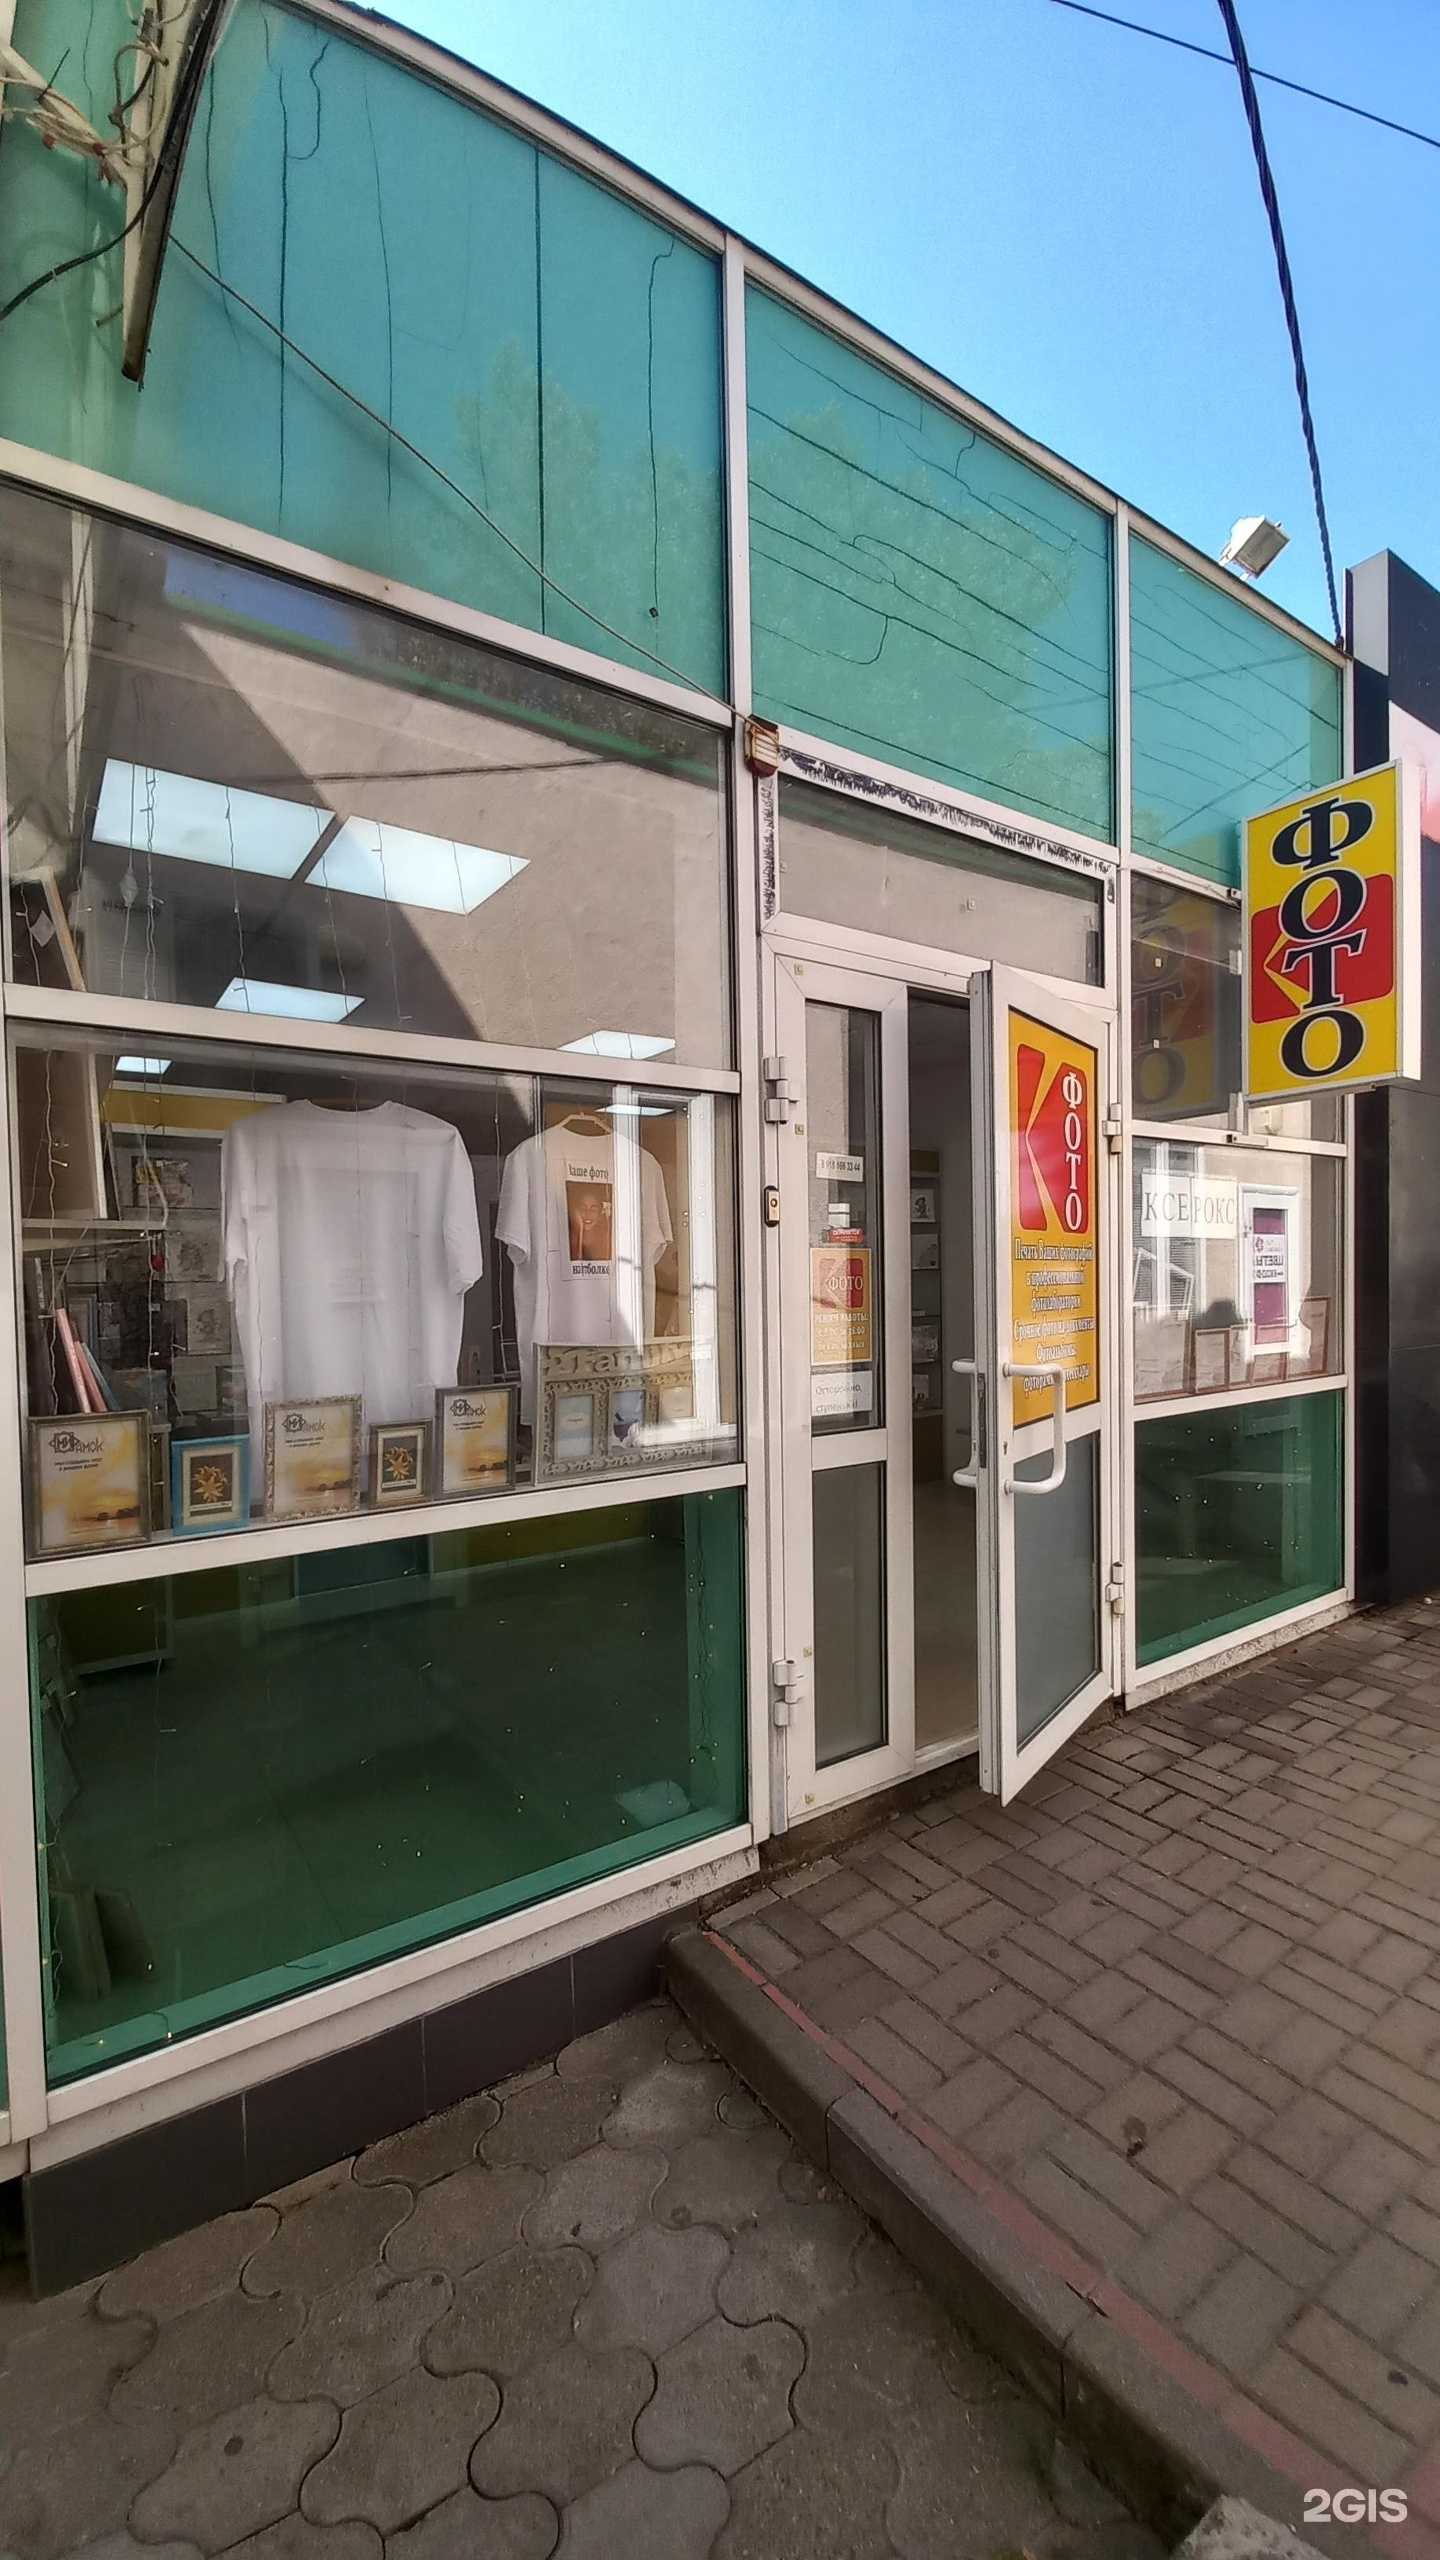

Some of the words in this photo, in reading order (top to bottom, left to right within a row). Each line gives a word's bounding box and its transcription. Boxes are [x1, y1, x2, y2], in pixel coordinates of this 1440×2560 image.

[1271, 796, 1376, 1080] ФОТО
[1062, 1071, 1083, 1232] ФОТО
[828, 1275, 863, 1291] ФОТО
